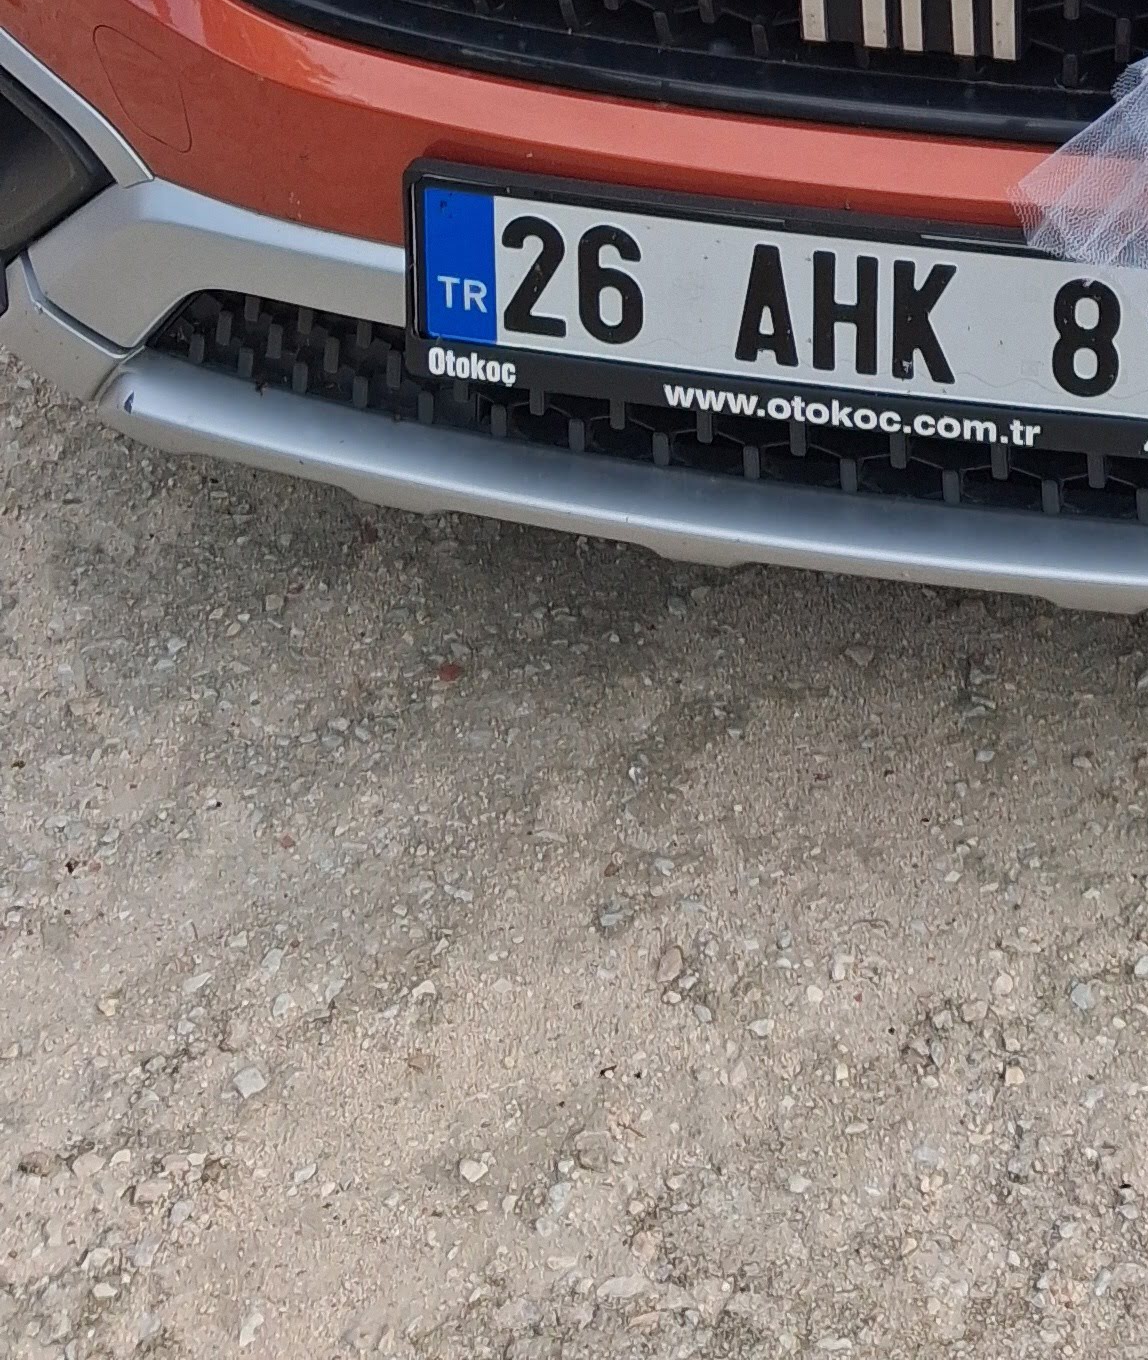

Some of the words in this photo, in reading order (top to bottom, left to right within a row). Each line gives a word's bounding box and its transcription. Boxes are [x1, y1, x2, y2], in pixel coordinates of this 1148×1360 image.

[437, 274, 488, 314] TR
[501, 214, 645, 345] 26
[734, 243, 957, 385] AHK
[428, 345, 516, 387] Otokoç
[663, 383, 1041, 447] www.otokoc.com.tr
